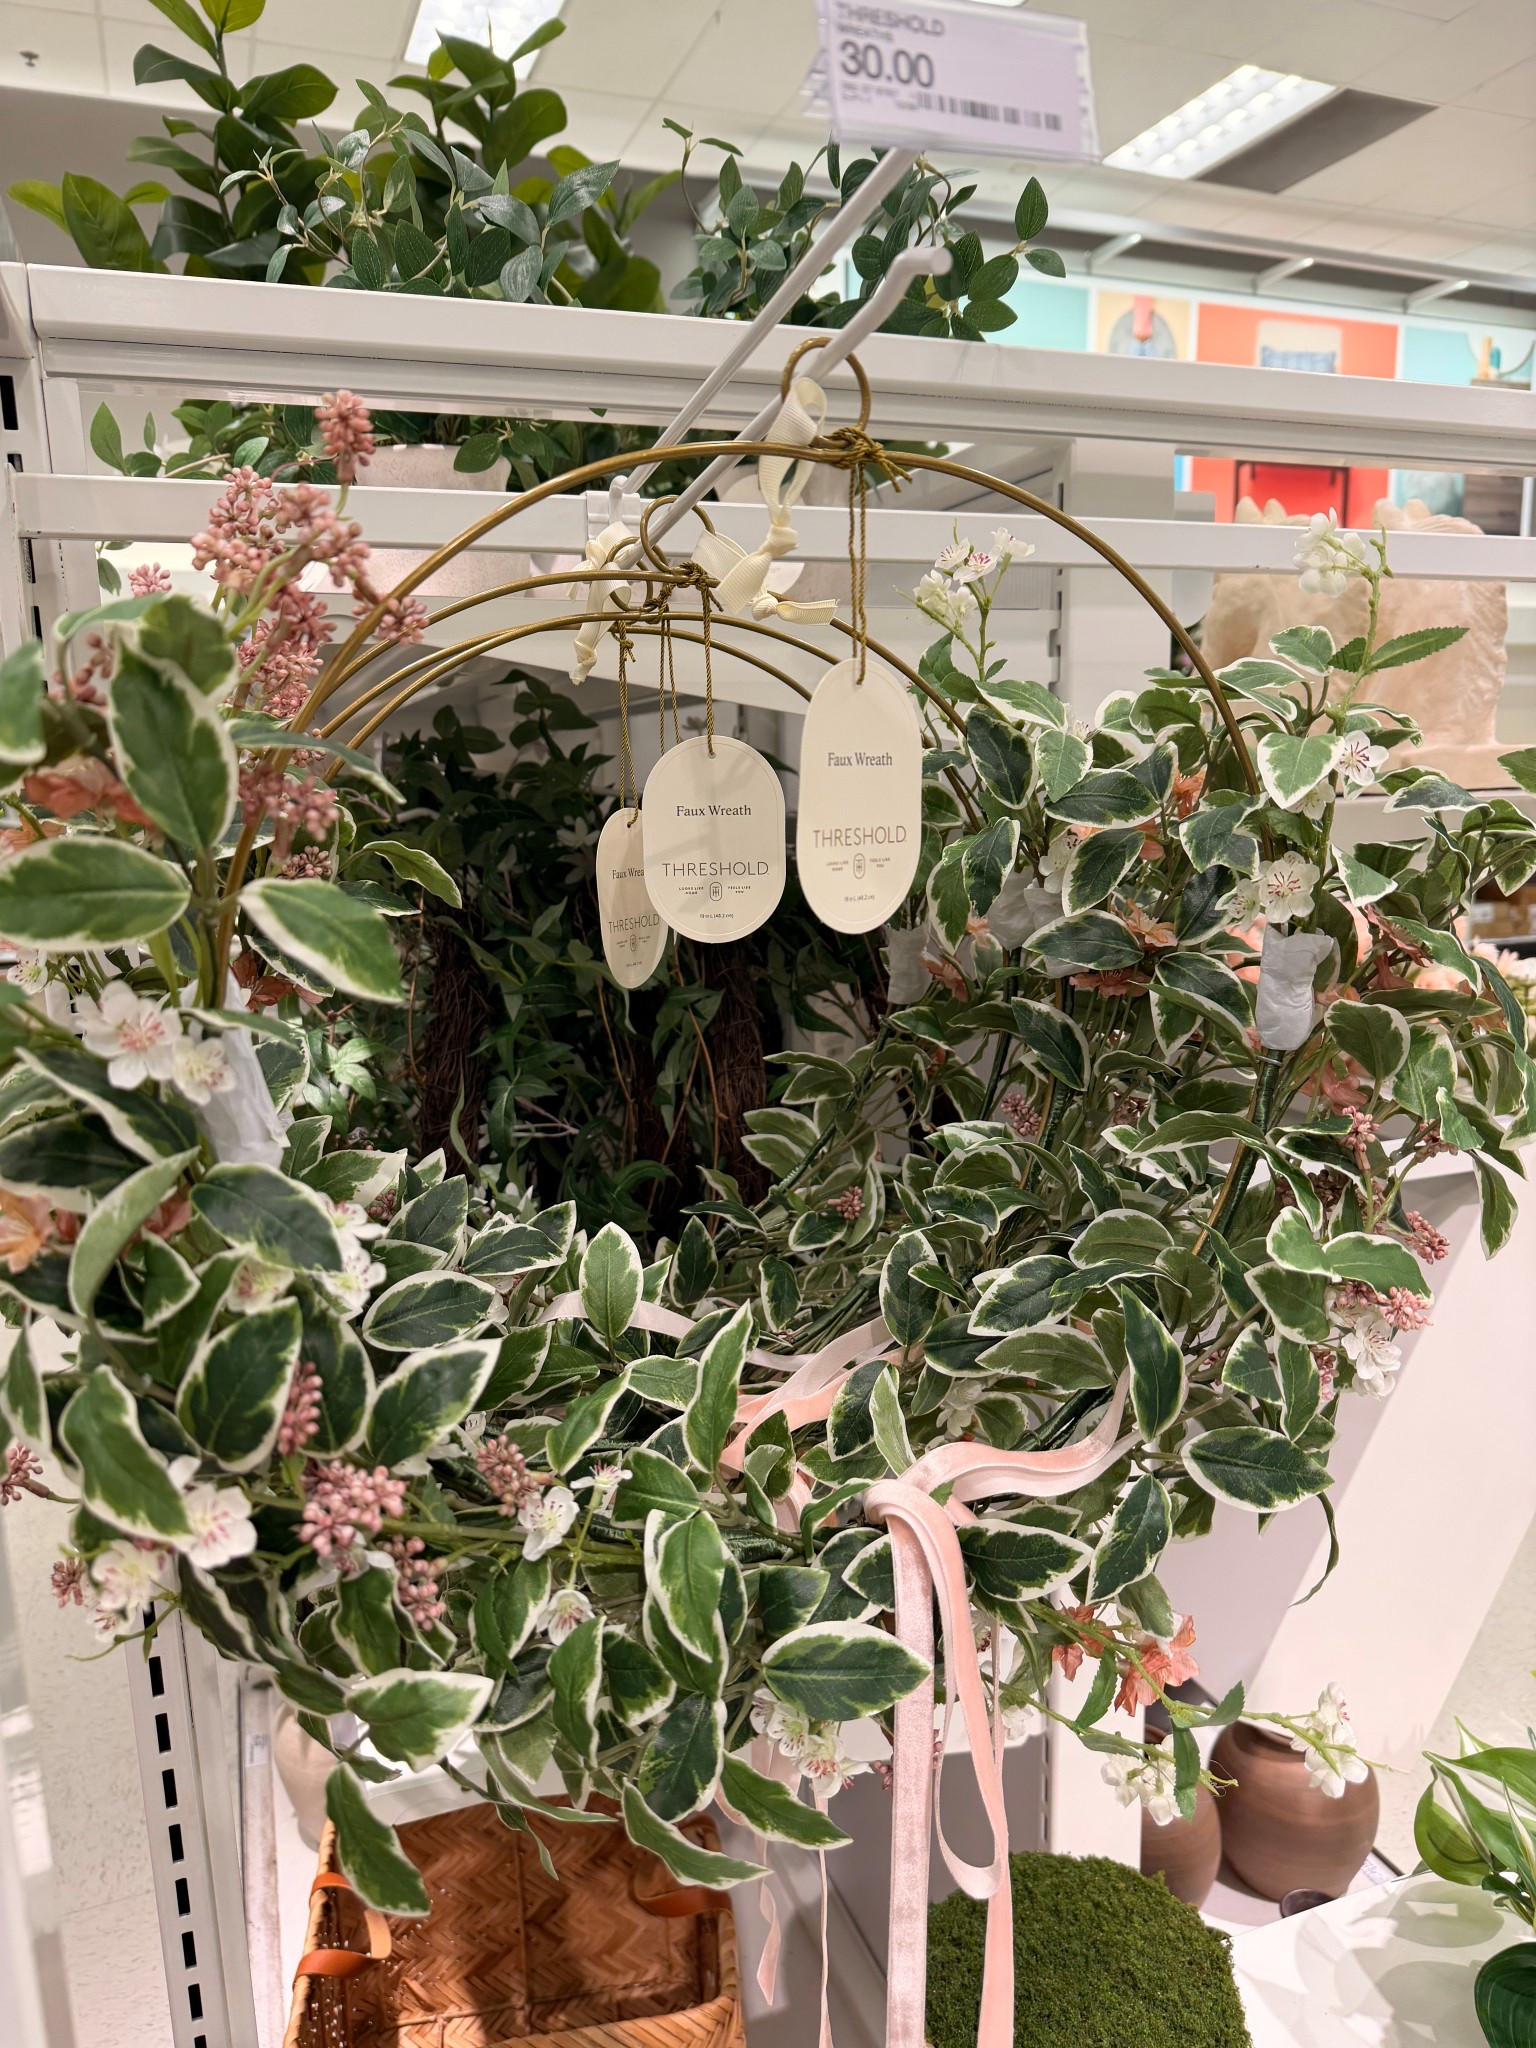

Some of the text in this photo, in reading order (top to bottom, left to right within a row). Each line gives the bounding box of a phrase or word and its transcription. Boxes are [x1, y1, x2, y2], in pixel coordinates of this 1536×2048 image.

[840, 40, 934, 88] 30.00
[828, 751, 893, 767] Faux Wreath
[676, 804, 752, 817] Faux Wreath
[813, 825, 907, 848] THRESHOLD
[612, 867, 644, 880] Faux Wrea
[661, 861, 769, 877] THRESHOLD
[608, 913, 660, 934] THRESHOLD
